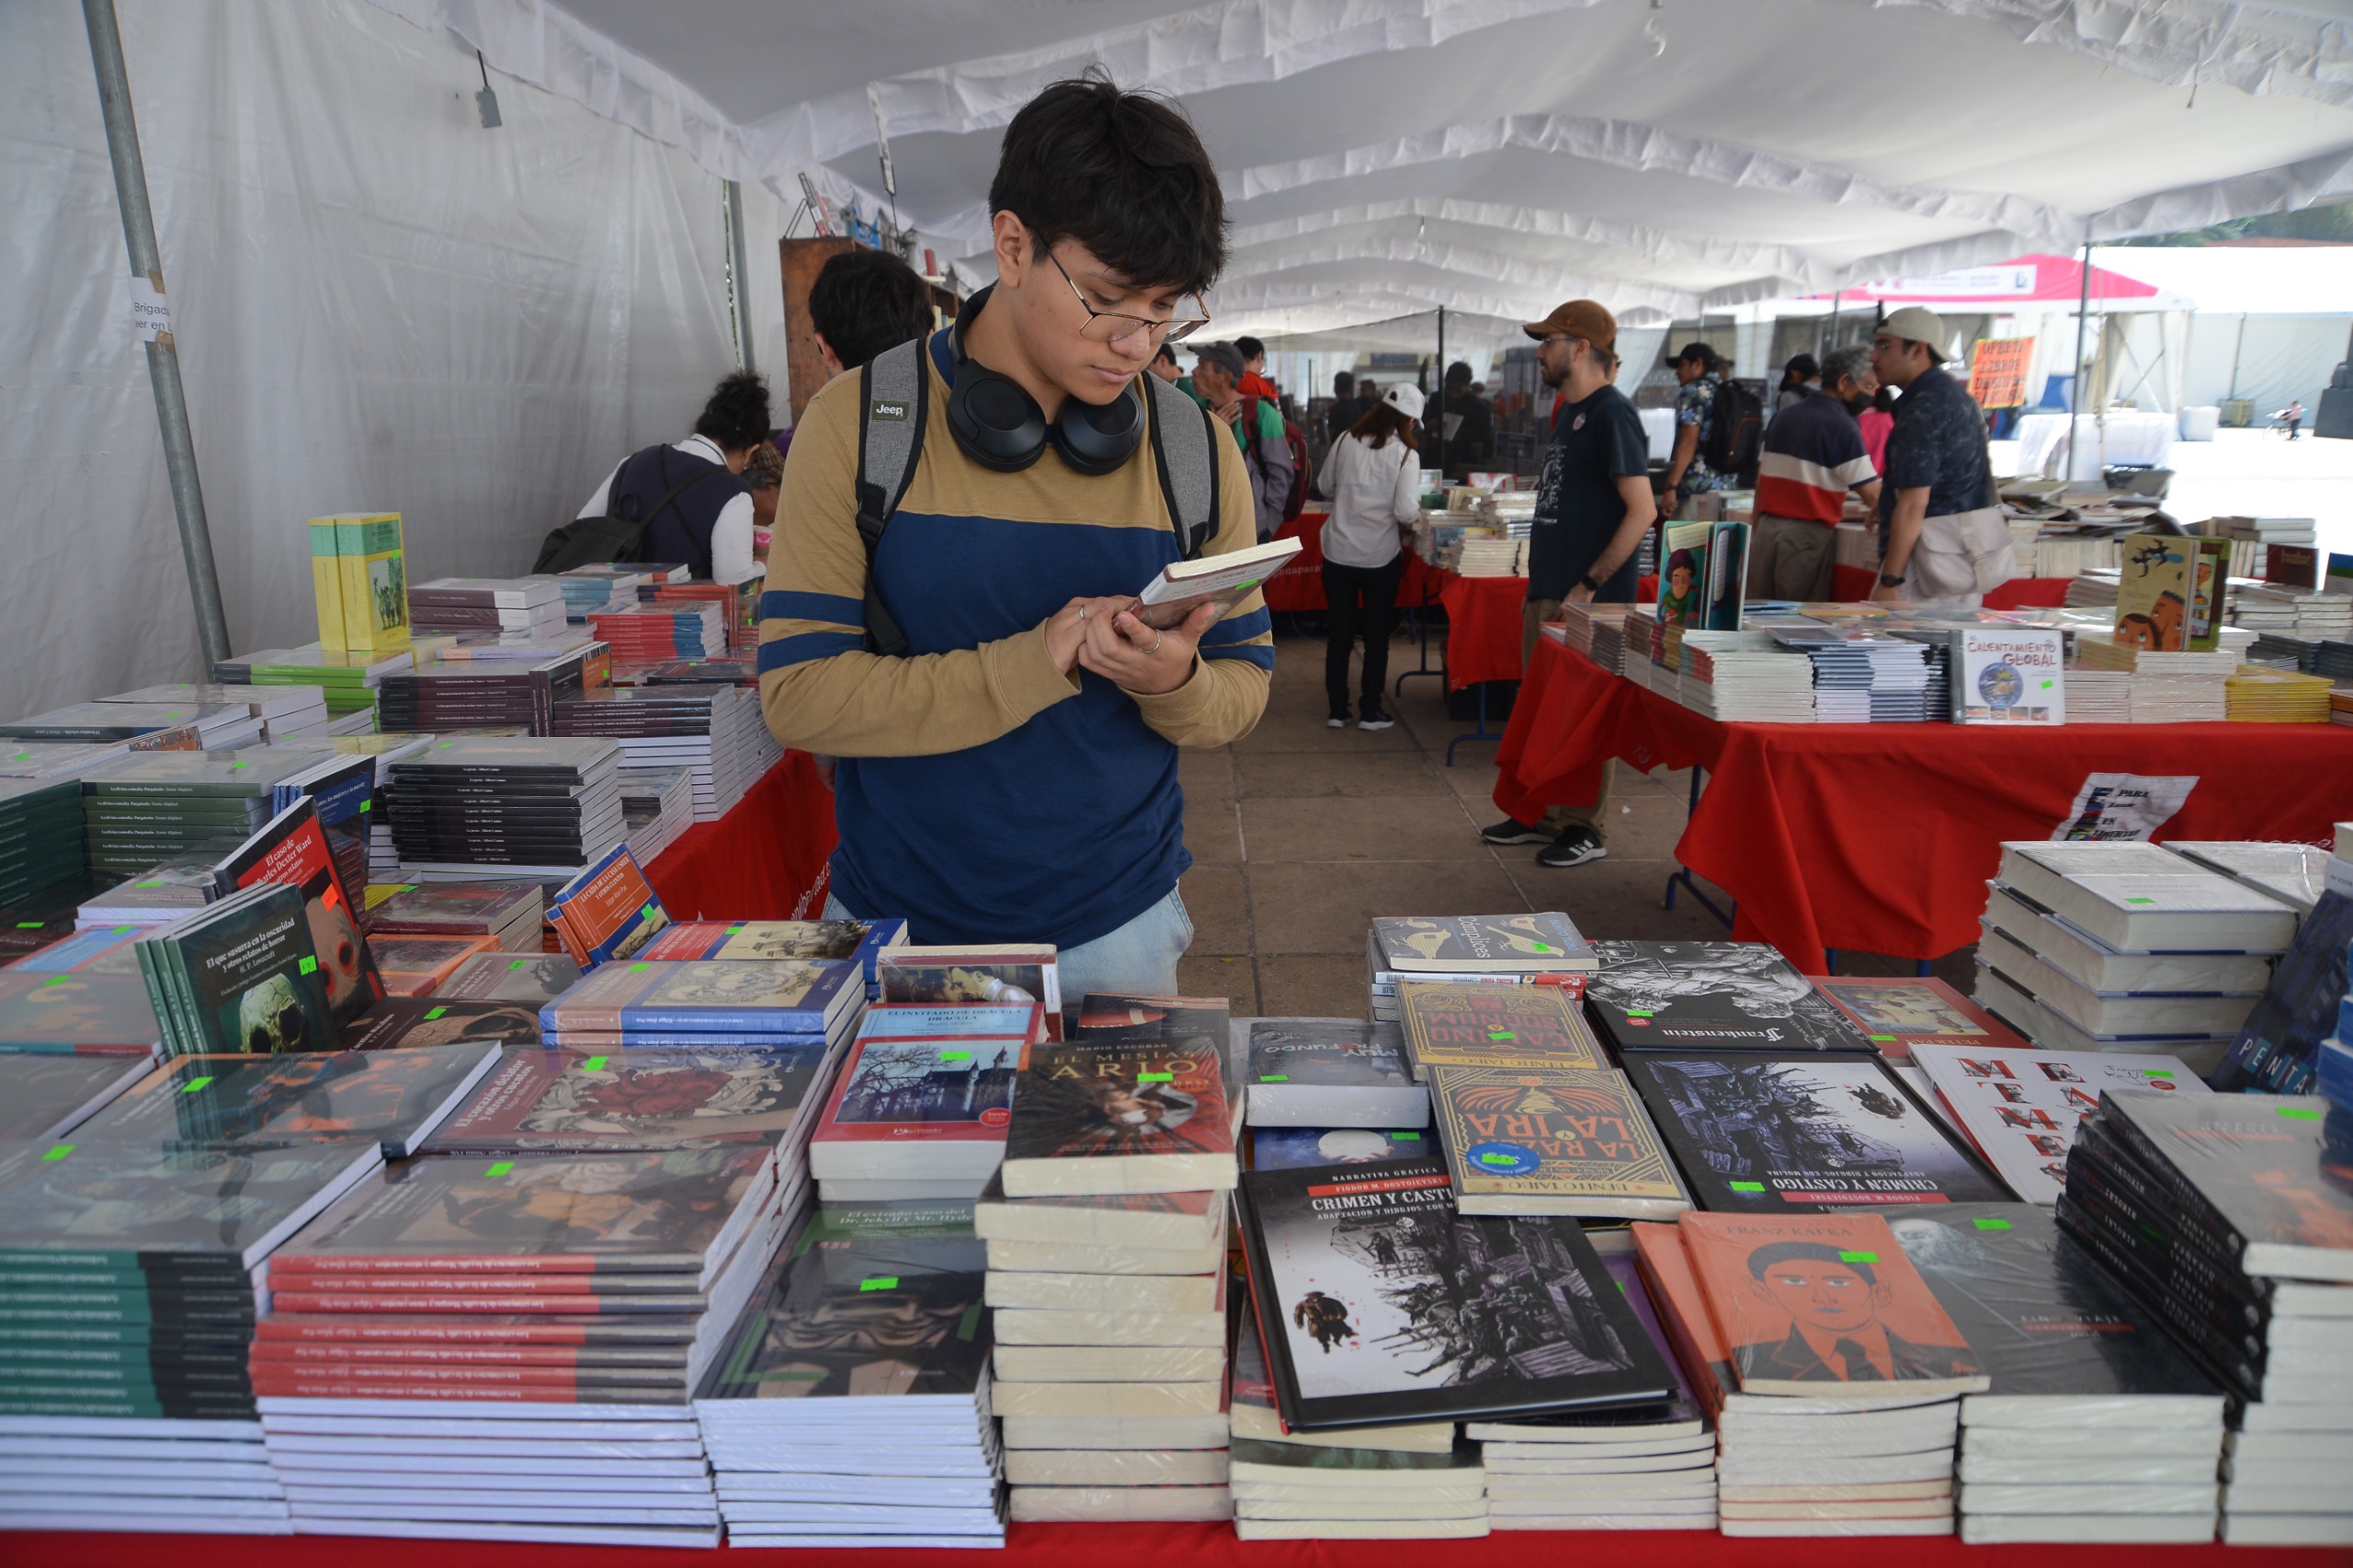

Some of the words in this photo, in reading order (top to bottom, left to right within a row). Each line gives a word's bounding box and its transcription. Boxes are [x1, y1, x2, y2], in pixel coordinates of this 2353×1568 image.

[876, 403, 904, 416] Jeep
[1969, 642, 2056, 653] CALENTAMIENTO
[2002, 653, 2057, 667] GLOBAL
[2118, 790, 2149, 798] PARA
[2093, 829, 2142, 837] LIBERTAD
[266, 855, 274, 867] El
[274, 846, 287, 860] caso
[287, 840, 294, 849] de
[276, 850, 296, 871] Dexter
[296, 835, 312, 853] Ward
[206, 958, 215, 969] El
[215, 953, 227, 967] que
[227, 941, 252, 958] susurra
[251, 937, 259, 946] en
[259, 934, 267, 942] la
[267, 917, 294, 938] oscuridad
[1458, 917, 1490, 958] Cómplices
[222, 965, 227, 973] y
[227, 958, 242, 968] otros
[241, 948, 261, 961] relatos
[261, 943, 268, 951] de
[268, 934, 286, 949] horror
[246, 962, 253, 971] P.
[253, 950, 275, 967] Lovecraft
[1428, 1013, 1560, 1029] SOGNUM
[1430, 1028, 1569, 1048] CAINO
[1662, 1028, 1785, 1042] Frankenstein
[1052, 1055, 1083, 1064] EL
[1049, 1060, 1199, 1081] ARIO
[455, 1119, 468, 1128] El
[467, 1082, 500, 1119] corazón
[495, 1060, 526, 1087] delator
[487, 1094, 507, 1115] otros
[505, 1065, 534, 1096] cuentos
[1467, 1113, 1551, 1137] IRA
[1564, 1115, 1632, 1141] LA
[1595, 1141, 1640, 1160] LA
[1333, 1171, 1390, 1182] NARRATIVA
[1383, 1178, 1443, 1188] DOSTOIEVSKI
[1772, 1178, 1847, 1190] CASTIGO
[1850, 1178, 1864, 1190] Y
[1865, 1178, 1938, 1190] CRIMEN
[1509, 1181, 1559, 1191] TAIBO
[1563, 1182, 1628, 1191] BENITO
[1312, 1195, 1380, 1211] CRIMEN
[1385, 1193, 1397, 1204] Y
[1402, 1187, 1454, 1203] CASTI
[1726, 1226, 1786, 1235] FRANZ
[1793, 1228, 1852, 1236] KAFKA
